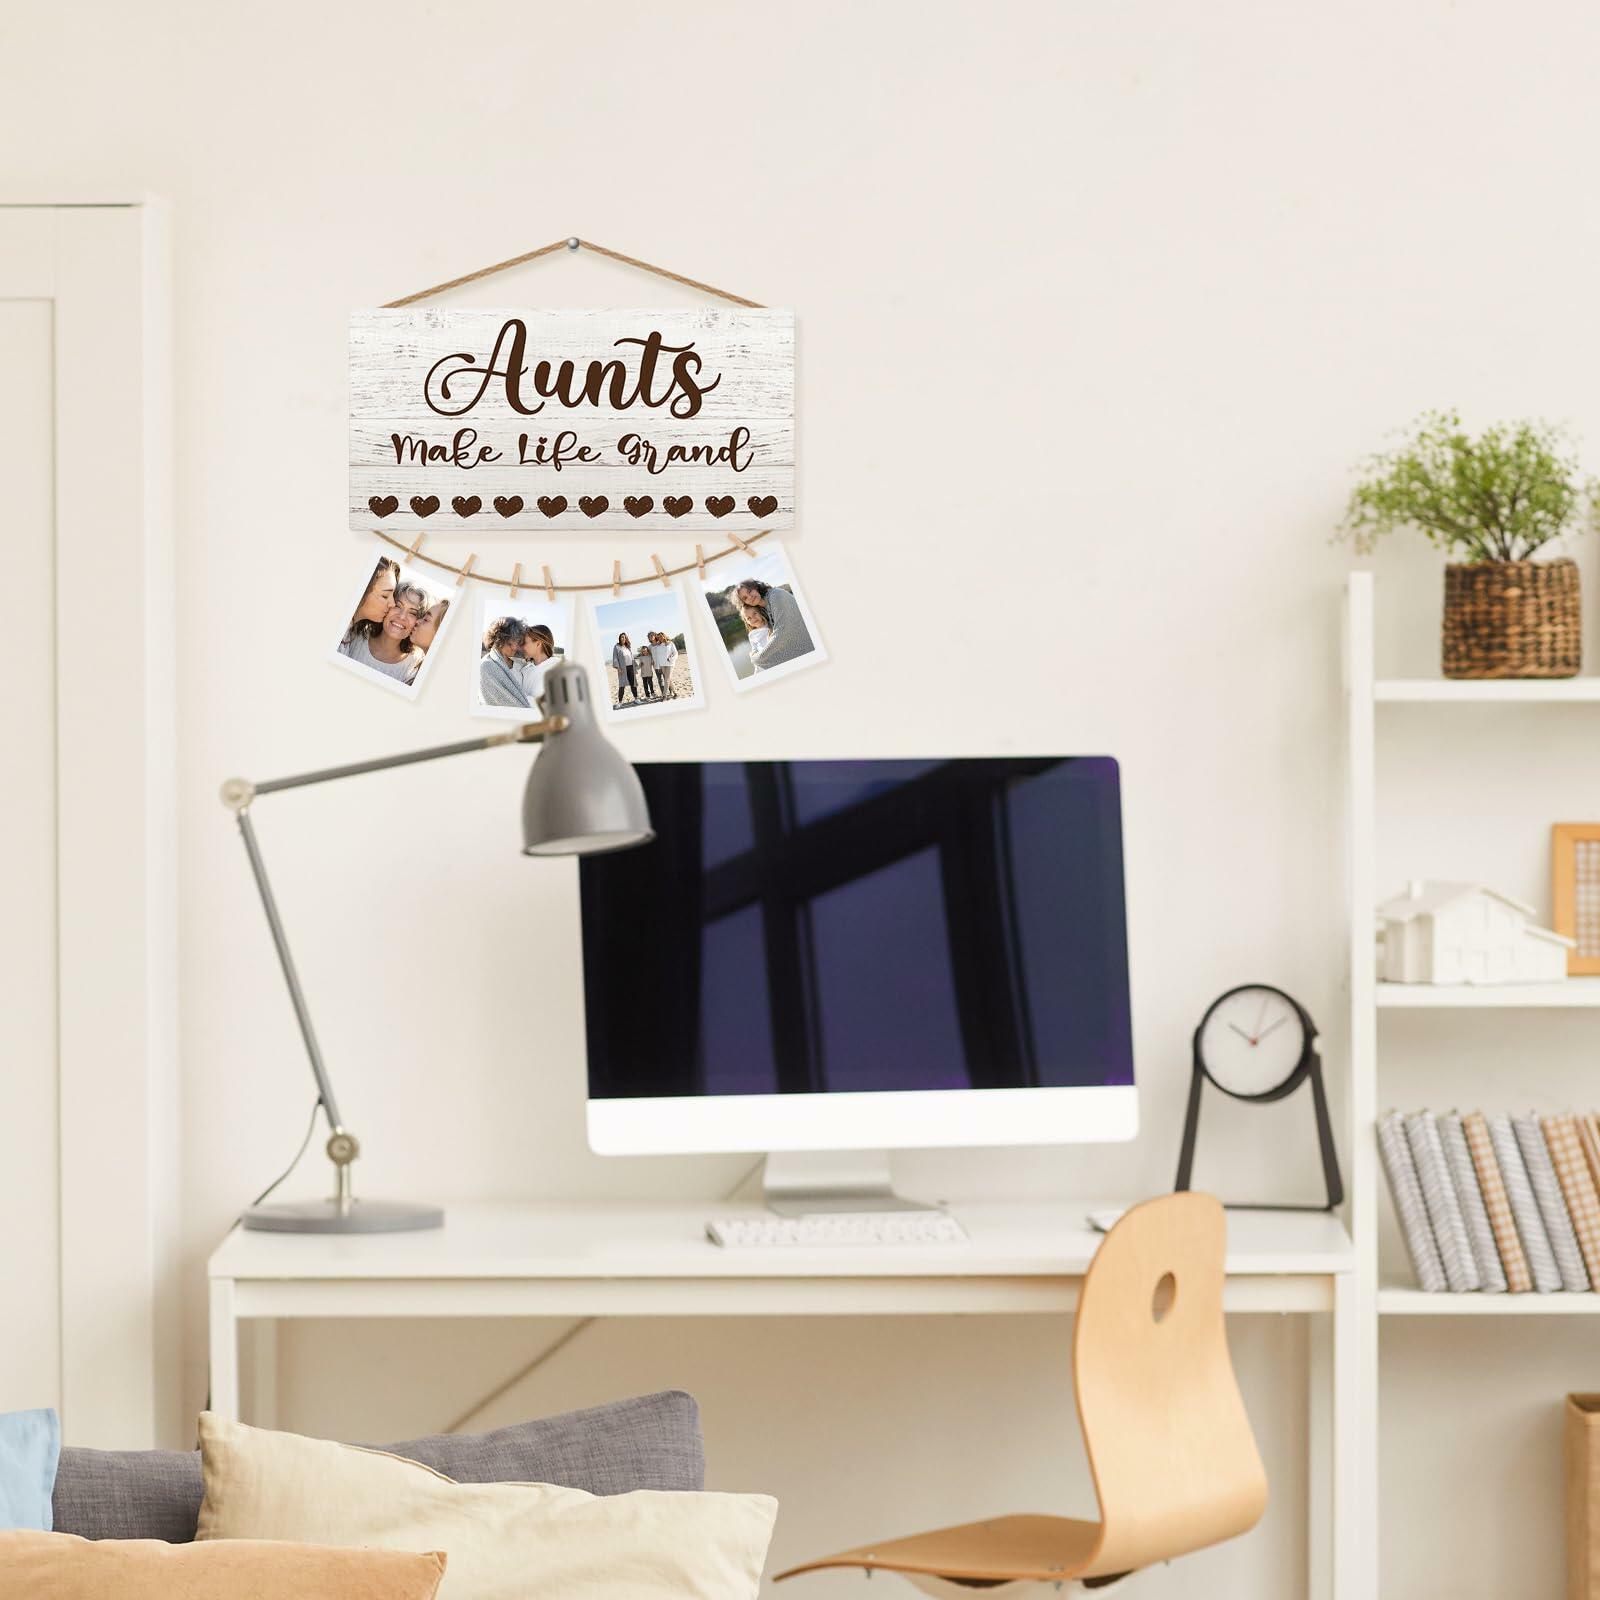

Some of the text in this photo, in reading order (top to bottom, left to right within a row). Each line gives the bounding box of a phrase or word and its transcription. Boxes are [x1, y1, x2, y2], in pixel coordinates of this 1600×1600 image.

[424, 318, 721, 419] Aunts
[391, 426, 754, 475] Make Life Grand
